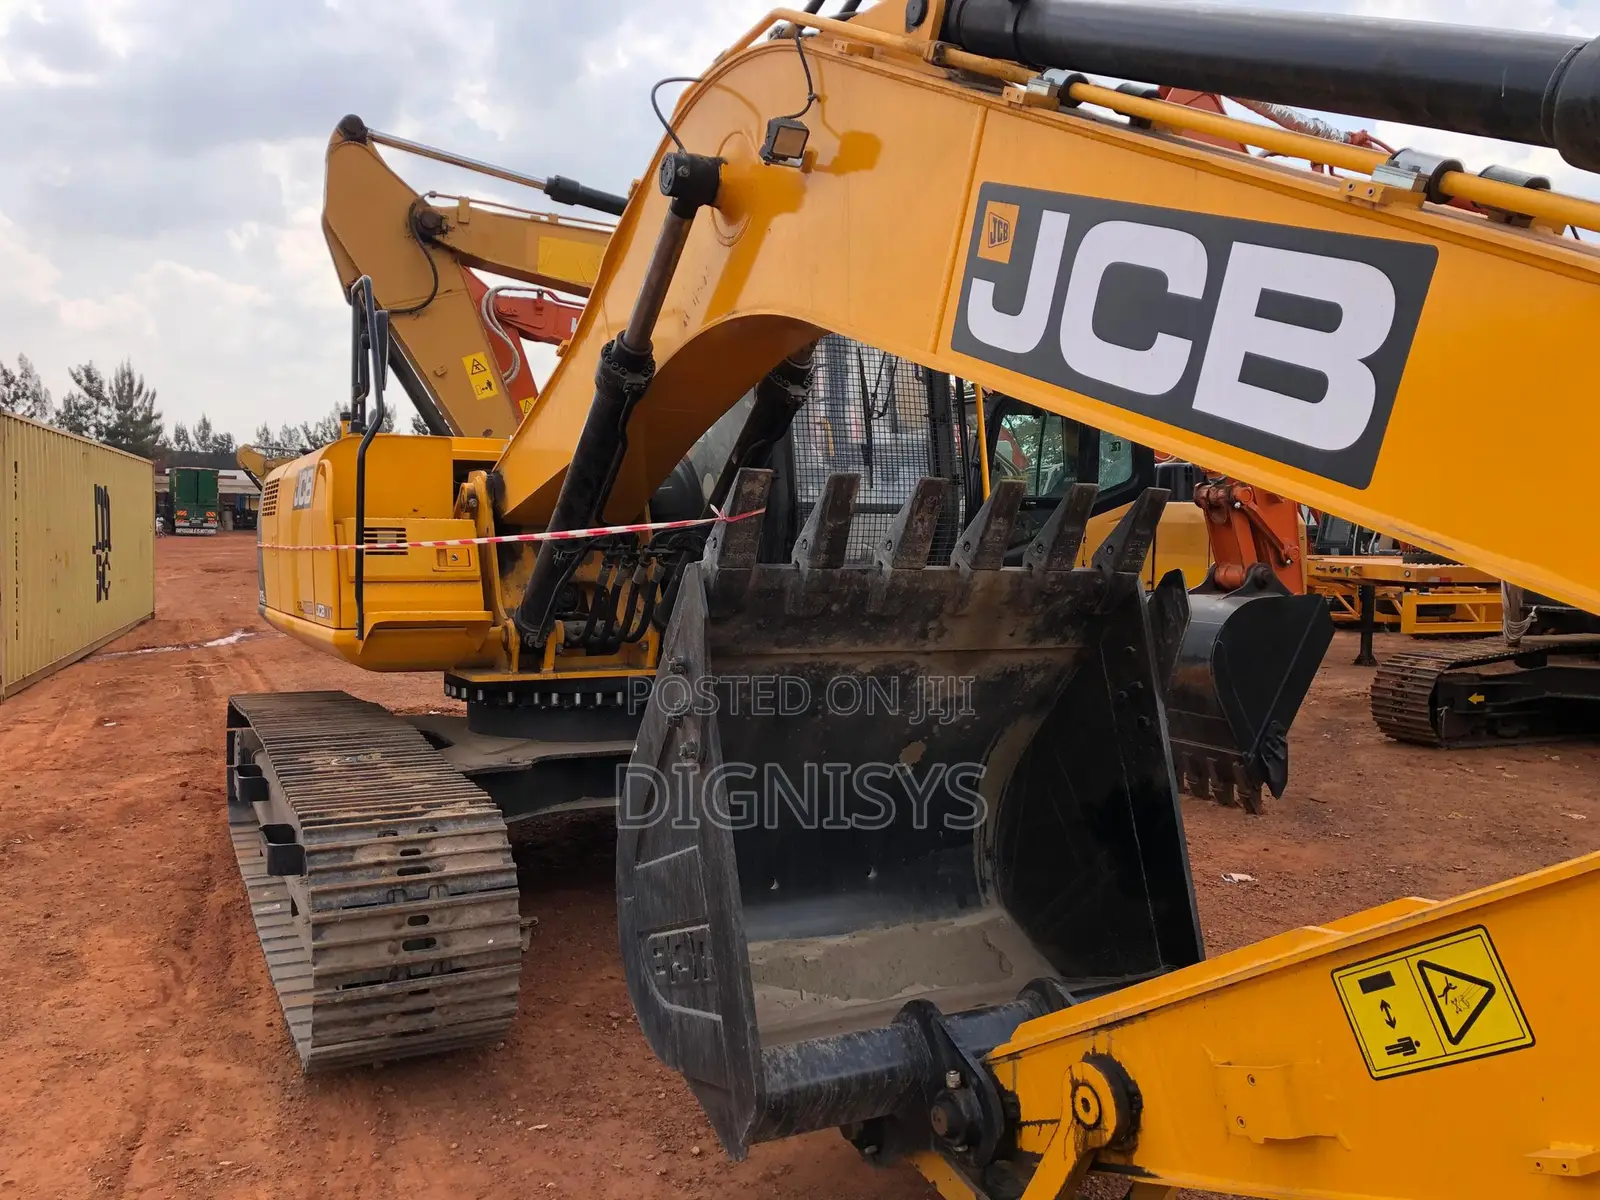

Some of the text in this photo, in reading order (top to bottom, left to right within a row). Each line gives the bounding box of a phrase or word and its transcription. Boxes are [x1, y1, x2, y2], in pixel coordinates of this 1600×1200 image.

[990, 216, 1008, 244] JCB
[967, 209, 1396, 450] JCB
[294, 468, 314, 507] JCB
